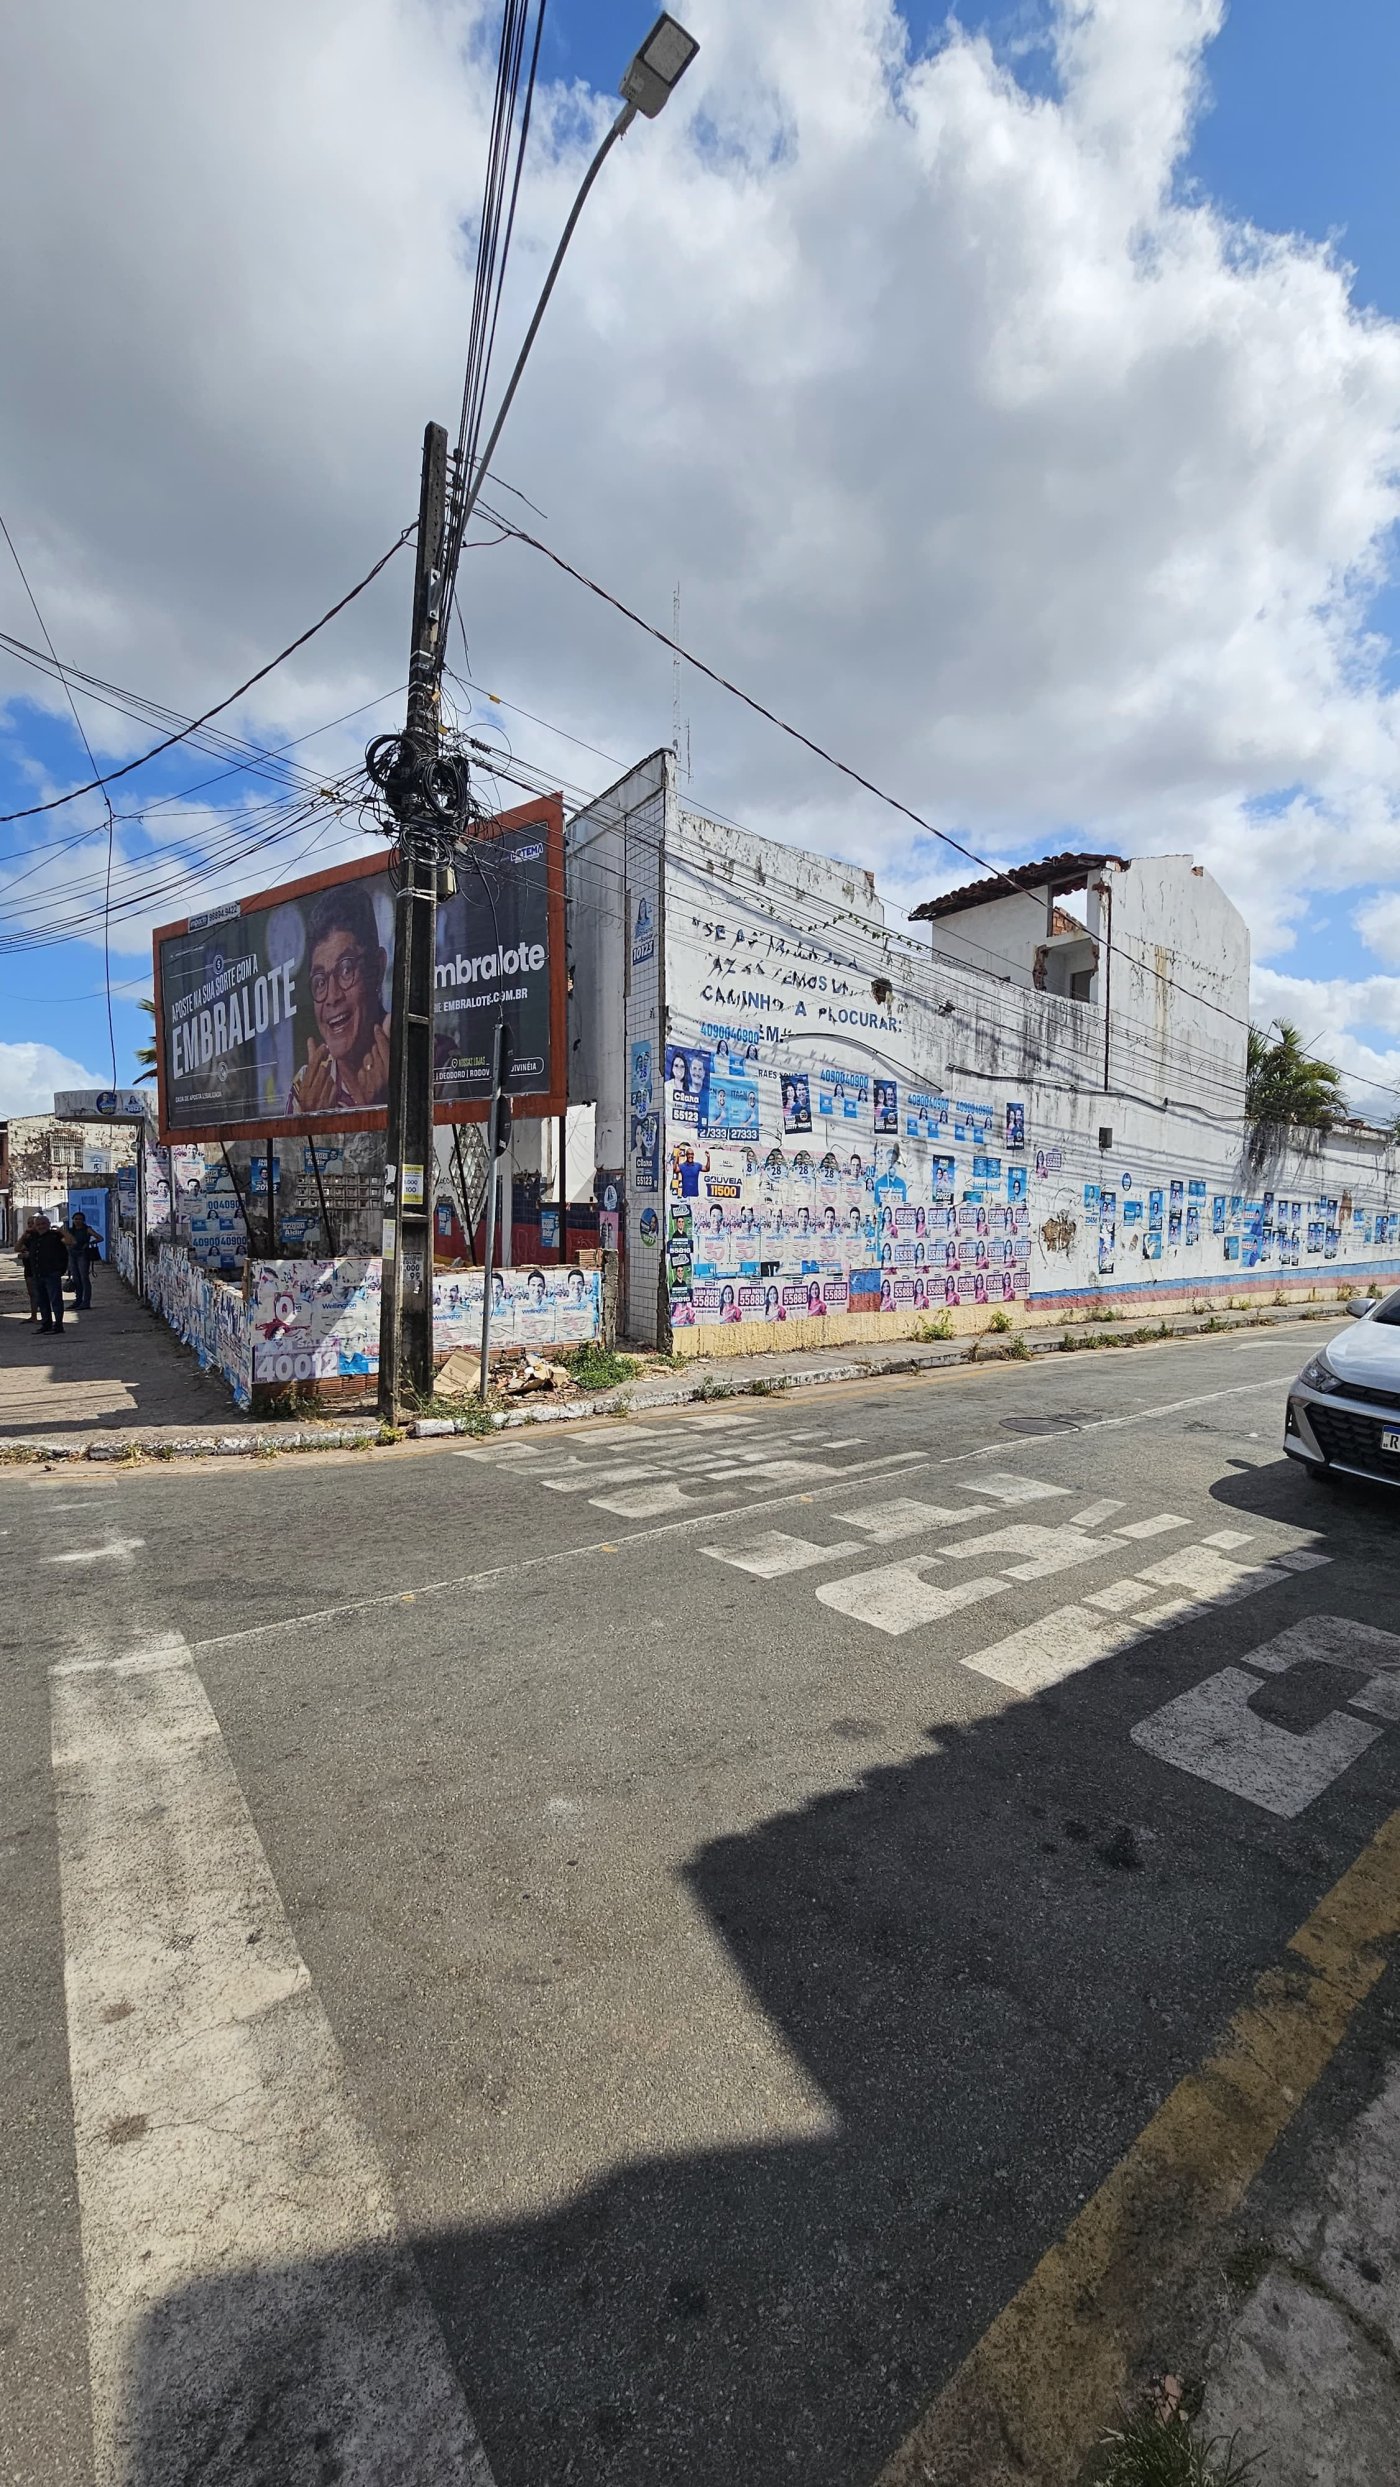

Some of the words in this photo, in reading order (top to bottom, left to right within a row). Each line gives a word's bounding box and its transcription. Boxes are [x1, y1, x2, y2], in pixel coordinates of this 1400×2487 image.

[633, 942, 653, 960] 10123
[434, 942, 545, 989] mbralote
[172, 994, 193, 1023] APOSTE
[193, 988, 203, 1009] NA
[202, 981, 216, 1003] SUA
[215, 967, 236, 999] SORTE
[236, 958, 252, 983] COM
[443, 988, 528, 1012] EMBRALOTE.COM.BR
[795, 1001, 807, 1017] A
[172, 958, 297, 1080] EMBRALOTE
[469, 1068, 490, 1077] RODOV
[673, 1110, 699, 1121] 55123
[731, 1129, 757, 1139] 27333
[771, 1167, 782, 1175] 28
[799, 1166, 809, 1175] 28
[824, 1170, 834, 1178] 28
[636, 1176, 653, 1185] 55123
[703, 1175, 743, 1185] GOUVEIA
[710, 1185, 737, 1197] 11500
[409, 1272, 421, 1280] 99
[740, 1294, 765, 1305] 55888
[784, 1293, 808, 1304] 55888
[825, 1289, 847, 1300] 55888
[322, 1302, 357, 1310] Wellington
[693, 1295, 720, 1307] 55888
[256, 1350, 338, 1382] 40012
